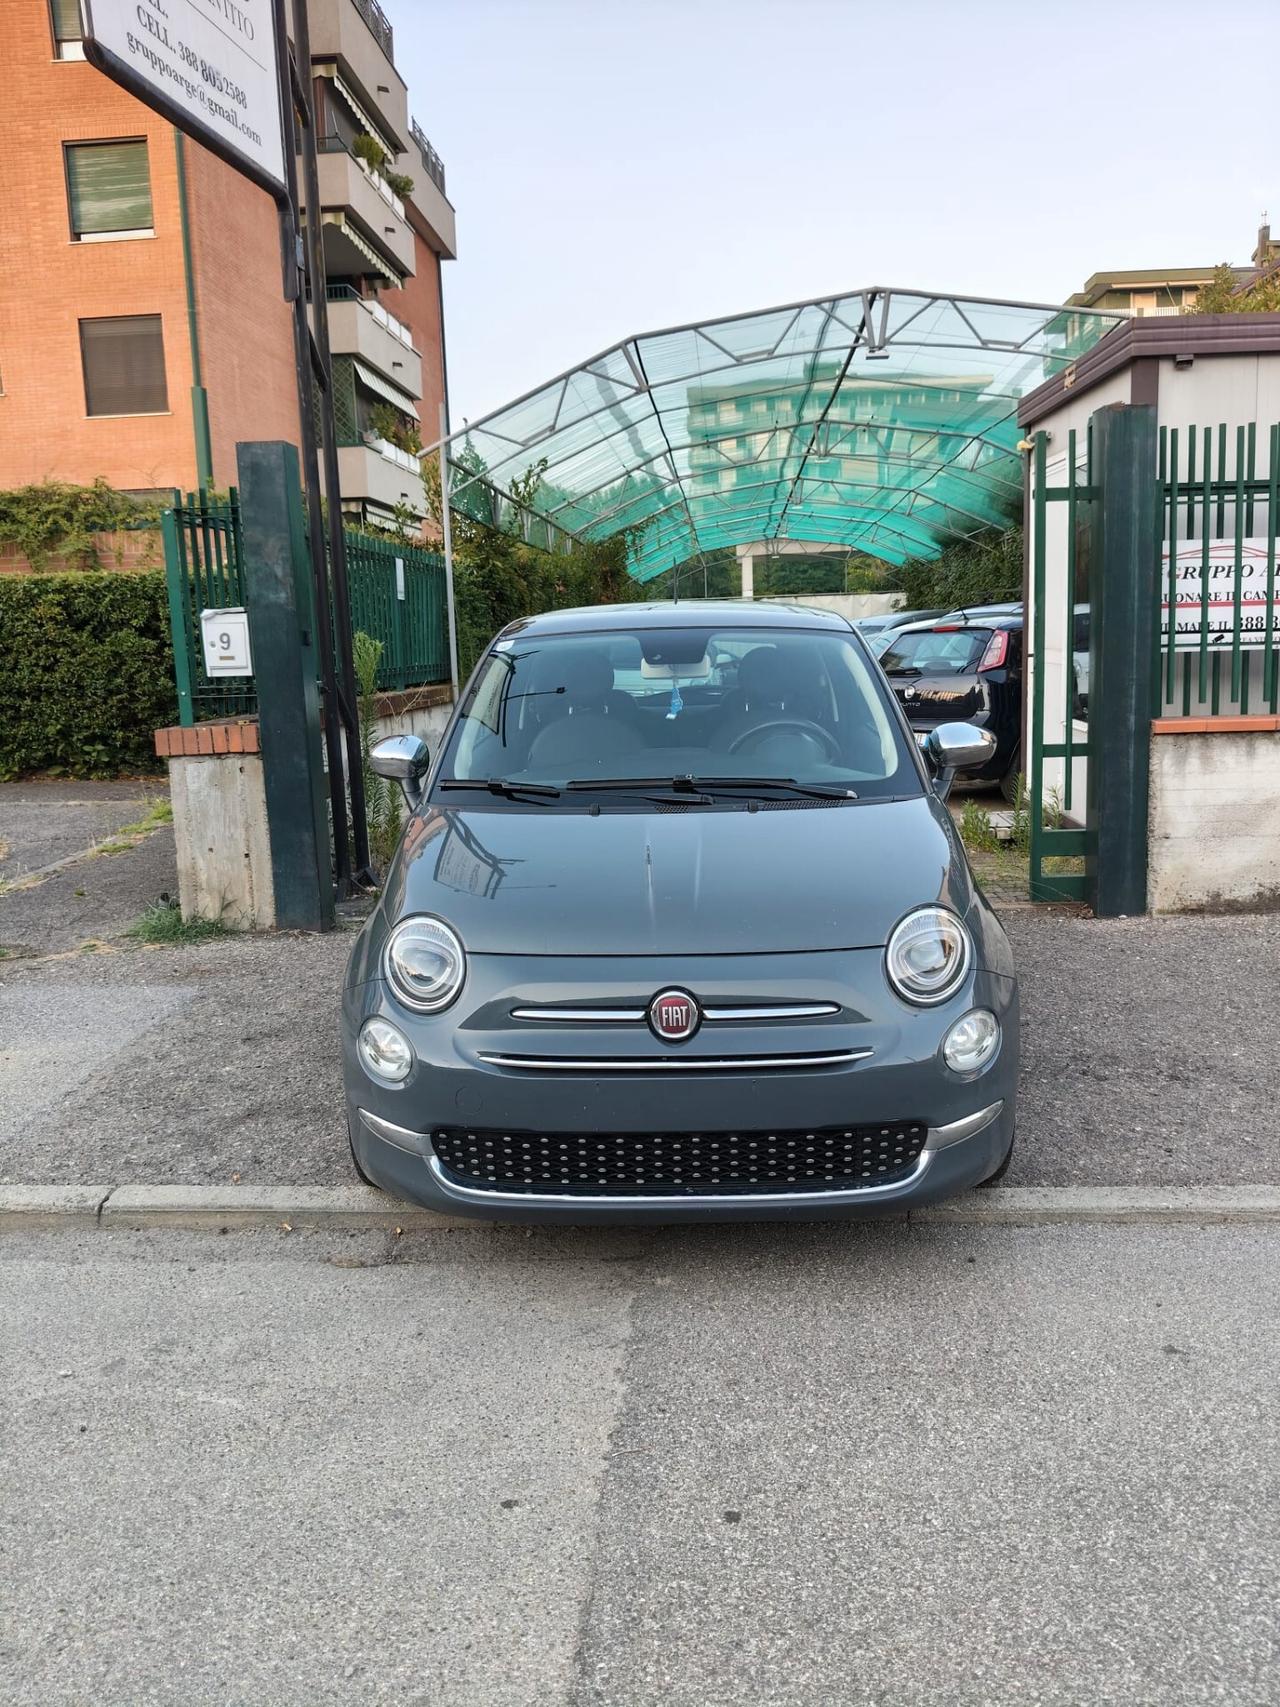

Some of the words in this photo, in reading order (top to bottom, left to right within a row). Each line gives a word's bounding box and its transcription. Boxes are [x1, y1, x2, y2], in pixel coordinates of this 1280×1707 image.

[136, 5, 176, 54] CELL.
[178, 41, 199, 72] 388
[126, 31, 262, 147] gruppoarge@gmail.com
[219, 632, 231, 651] 9
[661, 1006, 688, 1027] FIAT
